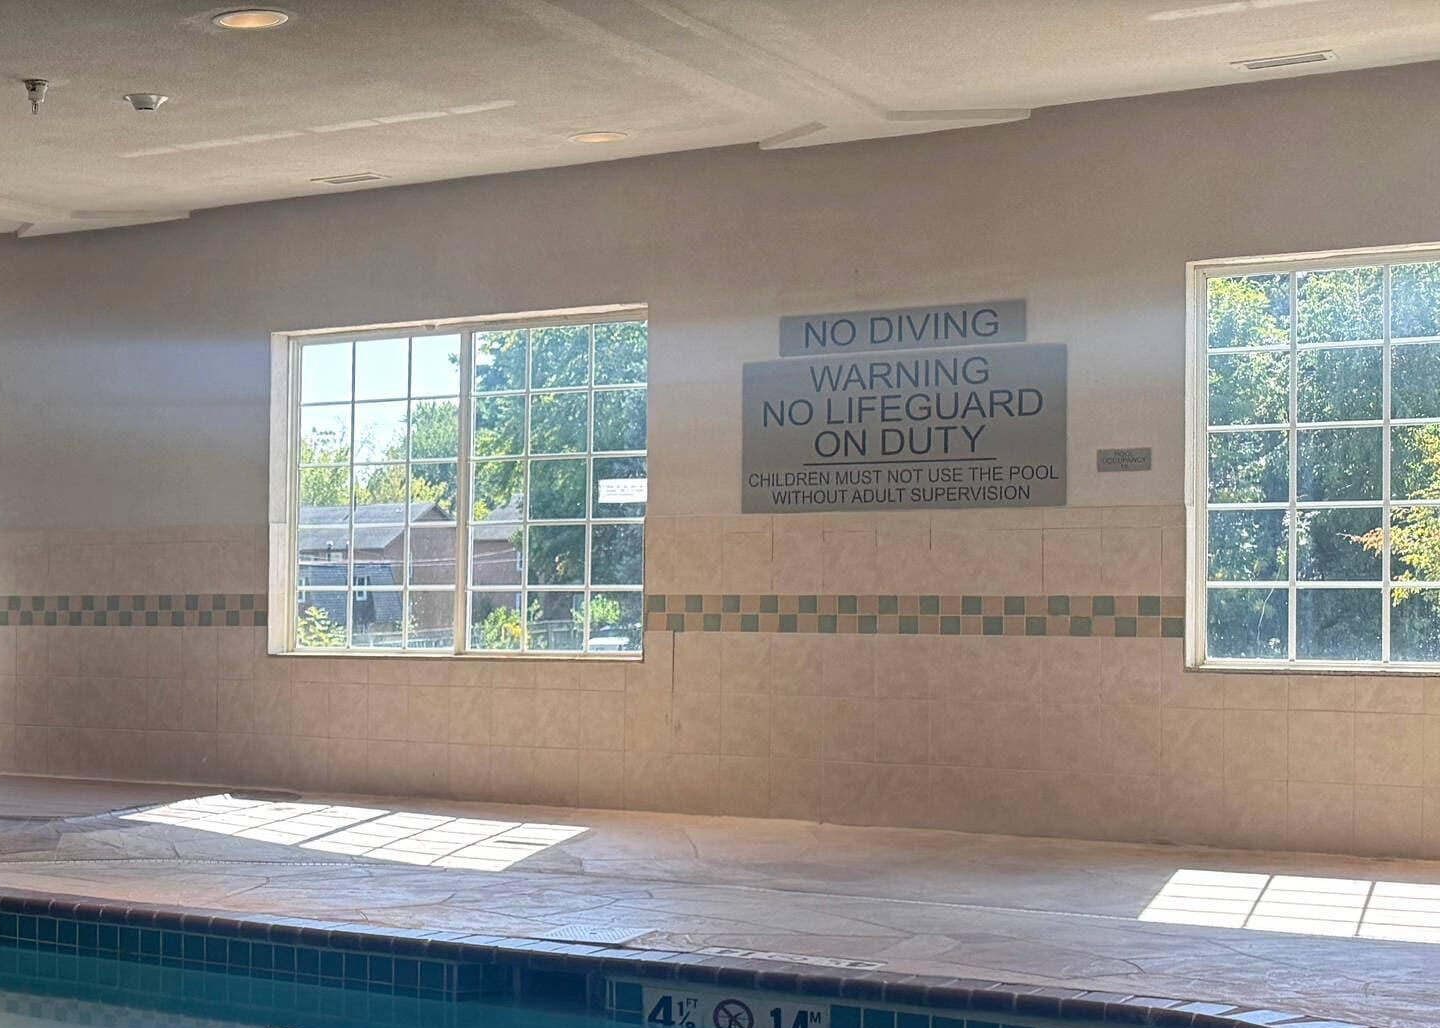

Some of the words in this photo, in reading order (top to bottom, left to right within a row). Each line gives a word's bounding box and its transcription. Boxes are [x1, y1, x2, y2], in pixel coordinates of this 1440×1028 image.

[804, 319, 857, 348] NO
[870, 309, 999, 345] DIVING
[810, 356, 990, 393] WARNING
[763, 399, 814, 427] NO
[827, 388, 1043, 425] LIFEGUARD
[815, 429, 866, 457] ON
[881, 424, 986, 456] DUTY
[748, 471, 830, 488] CHILDREN
[835, 469, 882, 485] MUST
[887, 469, 923, 484] NOT
[928, 467, 963, 483] USE
[968, 466, 1003, 481] THE
[1010, 464, 1059, 480] POOL
[772, 489, 848, 505] WITHOUT
[851, 488, 906, 503] ADULT
[911, 485, 1030, 502] SUPERVISION
